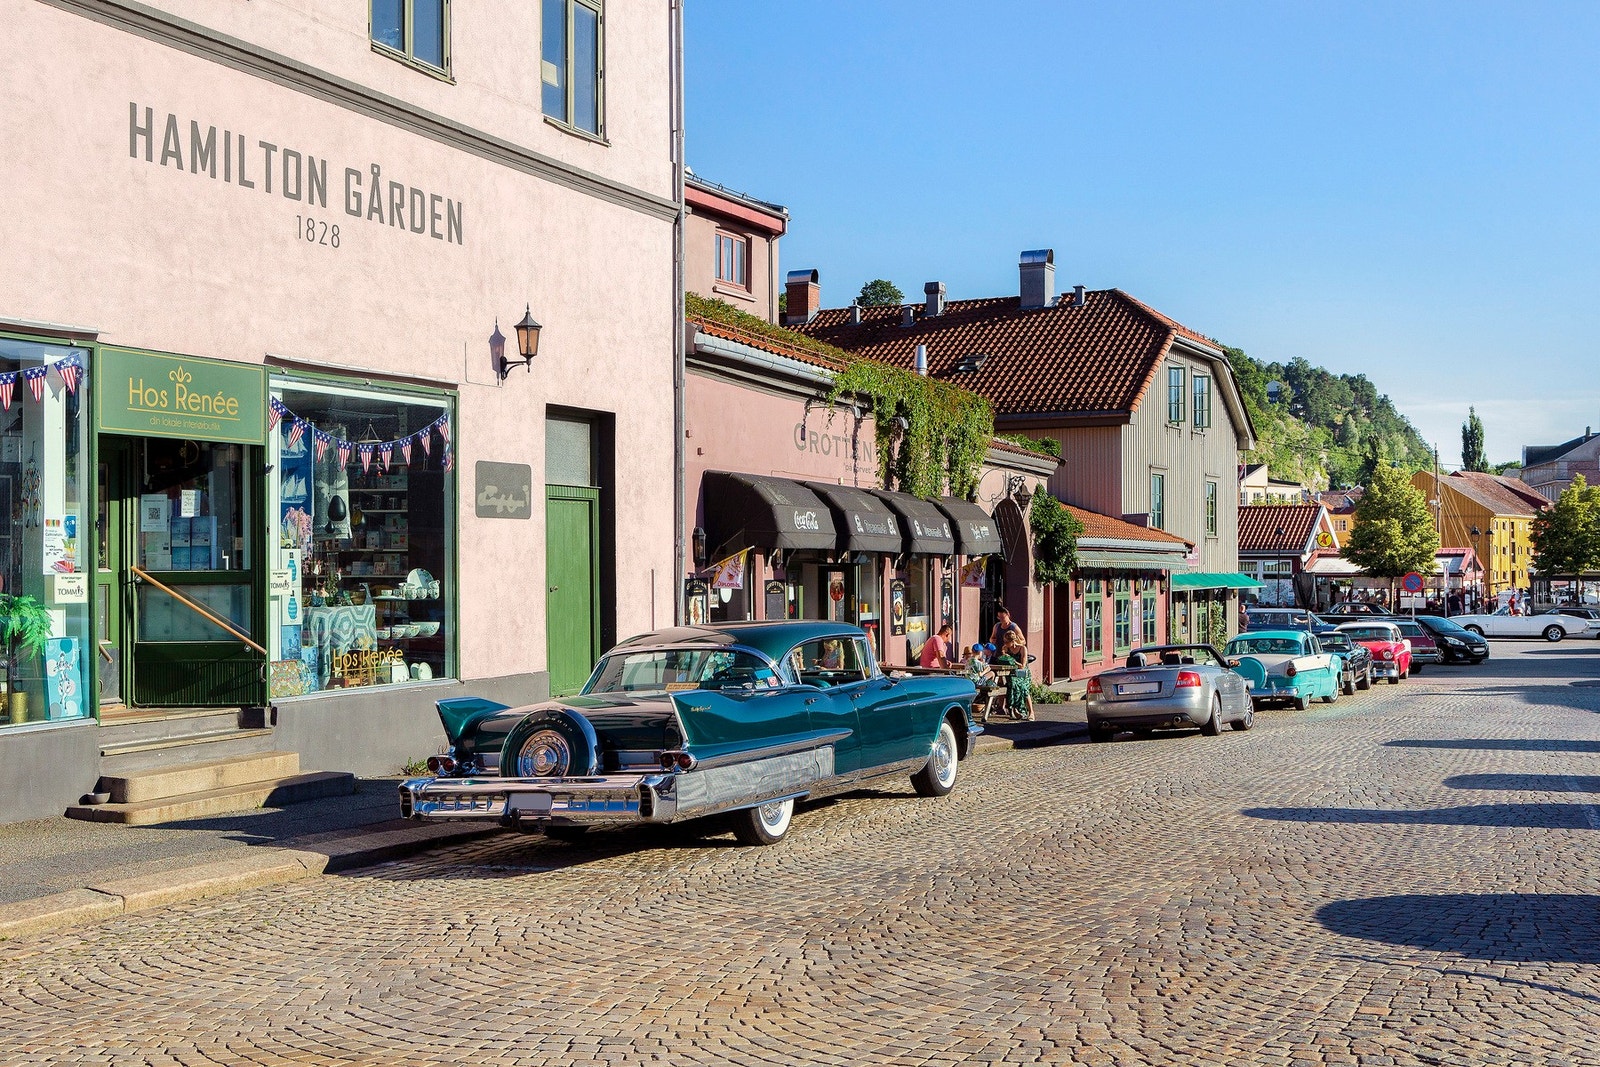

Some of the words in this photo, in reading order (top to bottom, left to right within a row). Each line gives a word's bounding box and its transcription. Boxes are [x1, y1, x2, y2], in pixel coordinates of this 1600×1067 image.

[129, 101, 327, 208] HAMILTON
[345, 163, 463, 245] GÅRDEN
[296, 214, 341, 249] 1828
[129, 377, 168, 408] Hos
[175, 383, 239, 415] Renée
[149, 416, 160, 425] din
[333, 648, 358, 669] Hos
[362, 646, 404, 666] Renée
